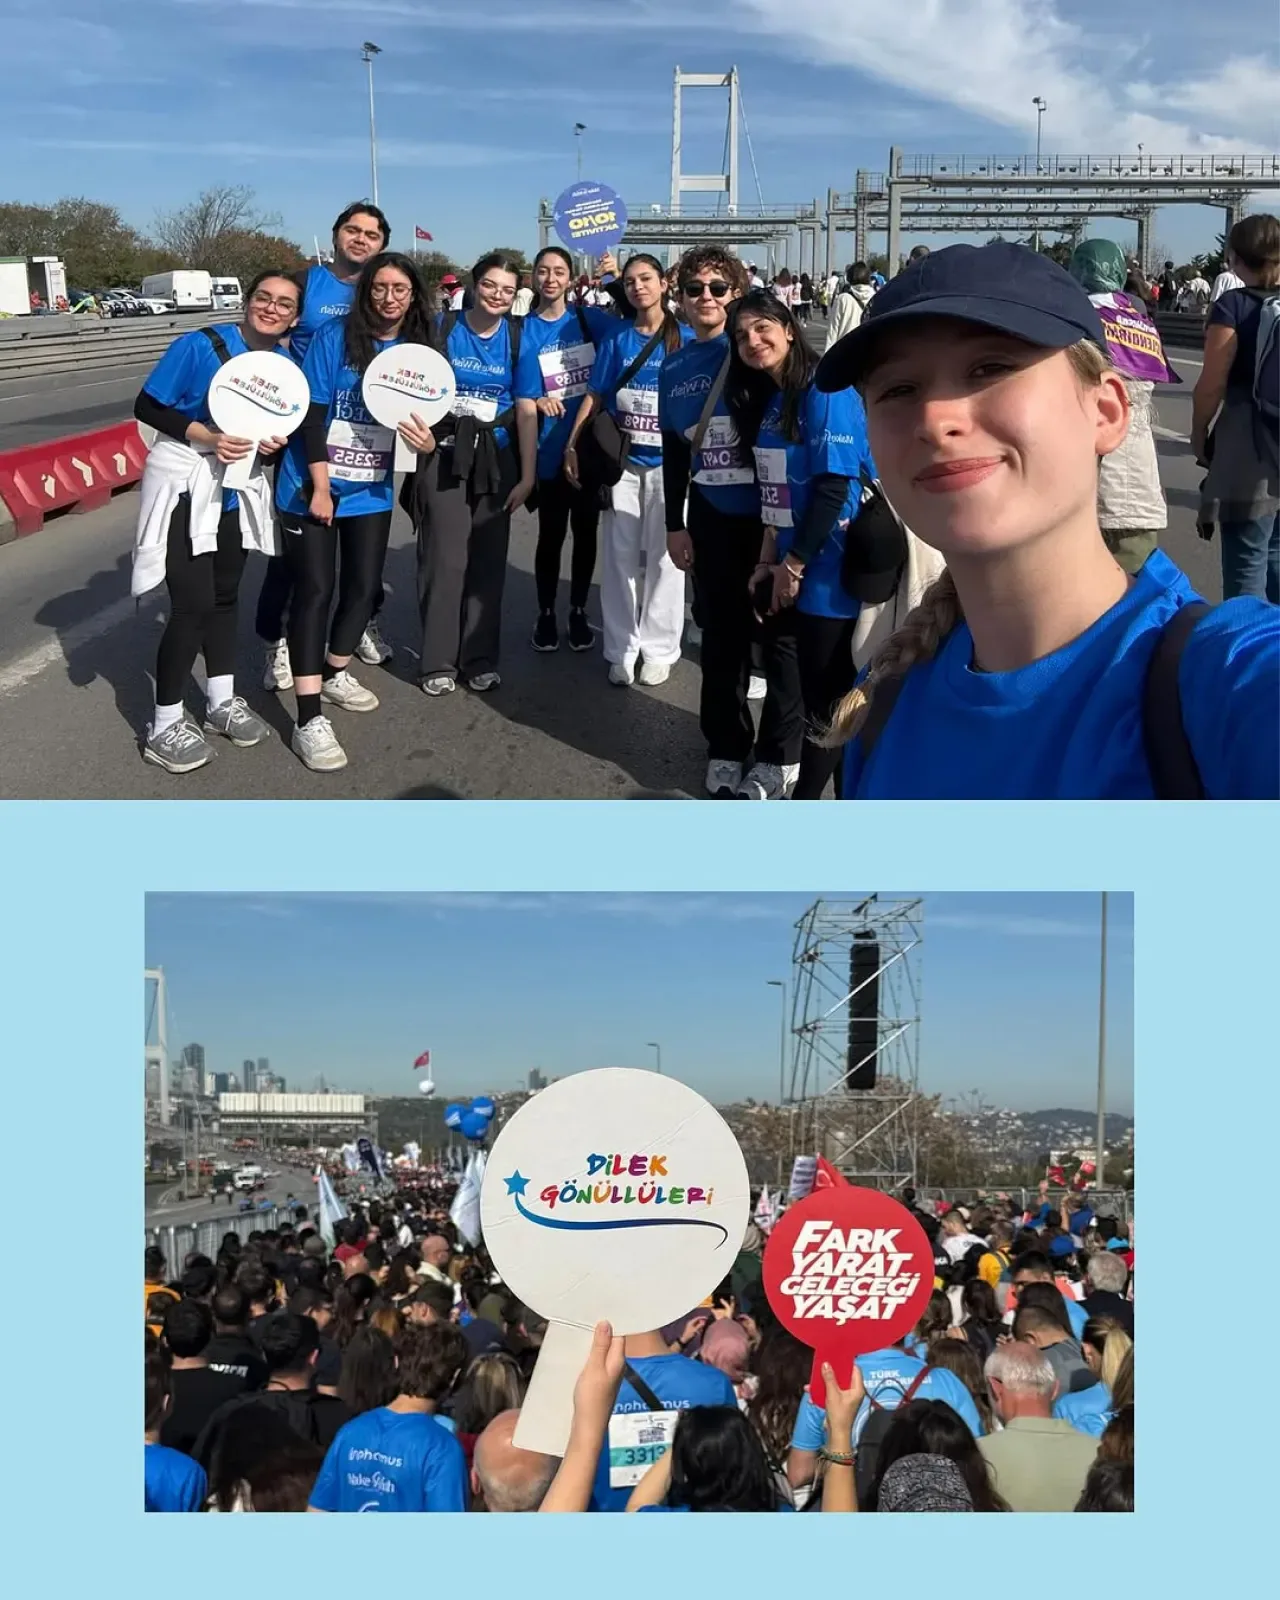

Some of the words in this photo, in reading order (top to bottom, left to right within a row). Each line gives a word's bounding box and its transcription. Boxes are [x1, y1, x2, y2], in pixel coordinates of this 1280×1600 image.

[587, 1153, 668, 1177] DİLEK
[540, 1179, 714, 1209] GÖNÜLLÜLERİ
[792, 1220, 902, 1253] FARK
[791, 1252, 913, 1277] YARAT
[780, 1273, 920, 1296] GELECEĞİ
[792, 1295, 907, 1325] YAŞAT
